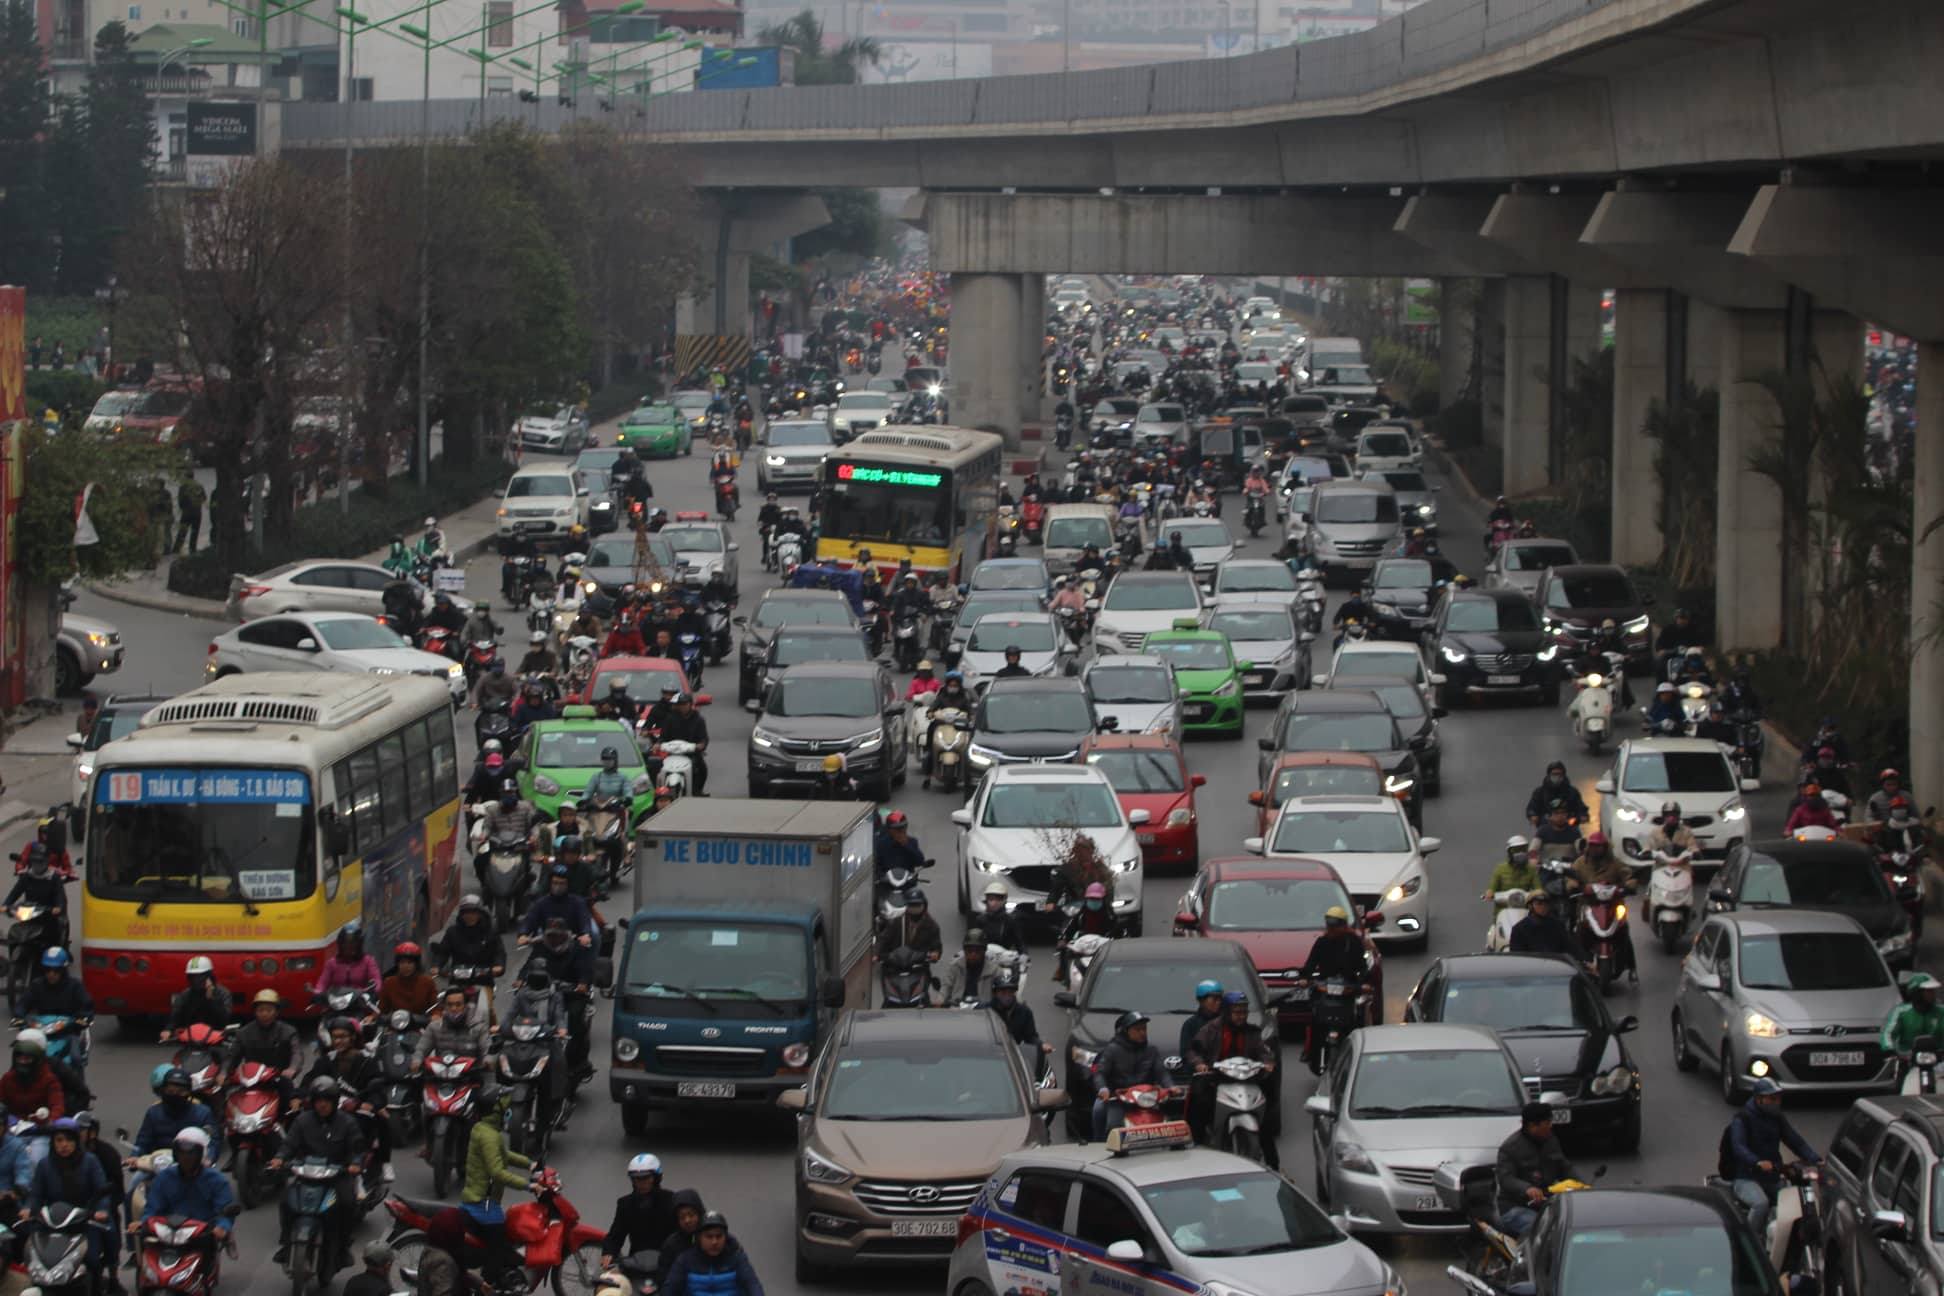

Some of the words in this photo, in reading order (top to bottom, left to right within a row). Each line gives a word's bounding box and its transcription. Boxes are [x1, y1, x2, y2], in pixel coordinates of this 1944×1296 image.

[110, 774, 141, 800] 19
[664, 839, 690, 863] XE
[637, 1022, 668, 1031] THACO
[744, 1026, 788, 1034] FRONTIER
